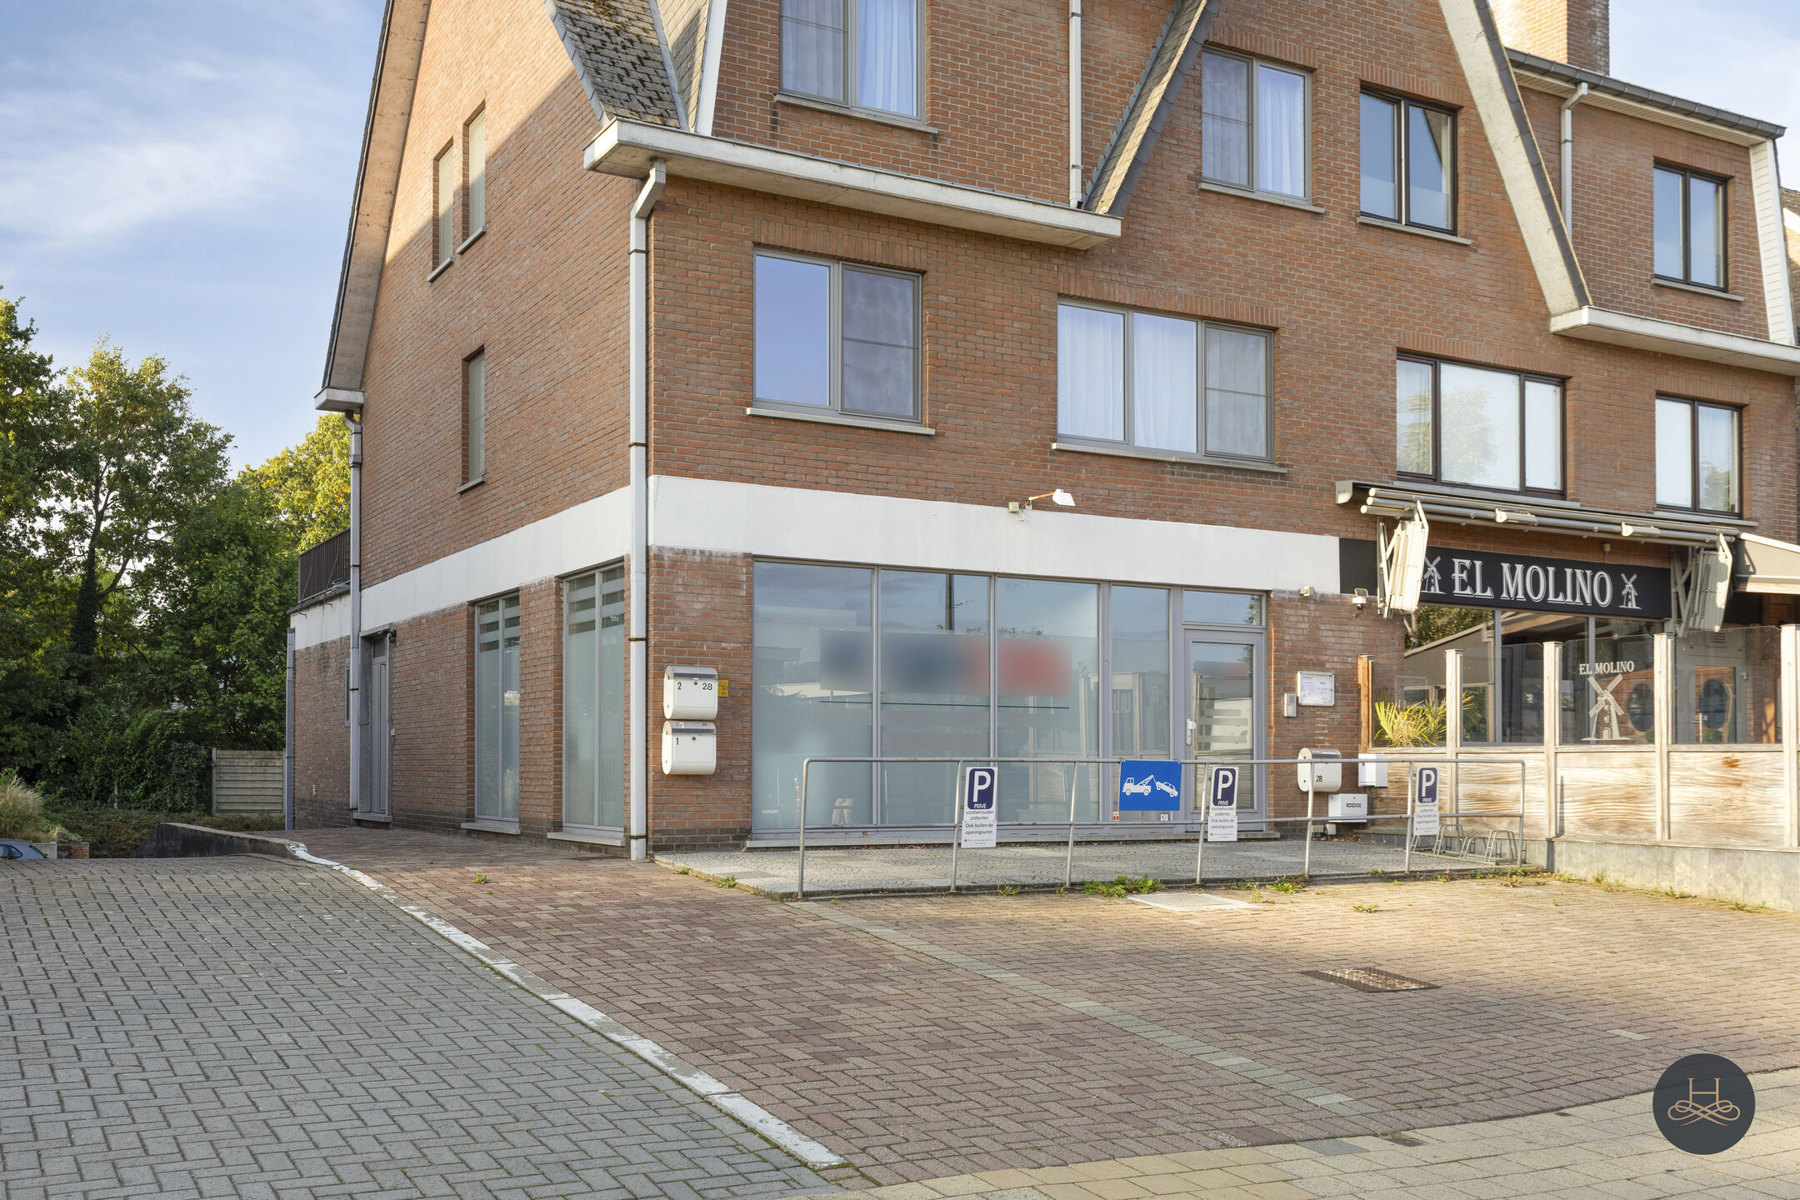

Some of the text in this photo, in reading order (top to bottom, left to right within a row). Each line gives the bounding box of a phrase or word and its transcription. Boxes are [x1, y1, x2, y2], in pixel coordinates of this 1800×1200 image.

[1451, 558, 1613, 608] EL MOLINO
[1579, 660, 1635, 676] EL MOLINO
[677, 682, 682, 690] 2
[973, 771, 991, 802] P
[1217, 770, 1233, 799] P
[1422, 770, 1435, 797] P
